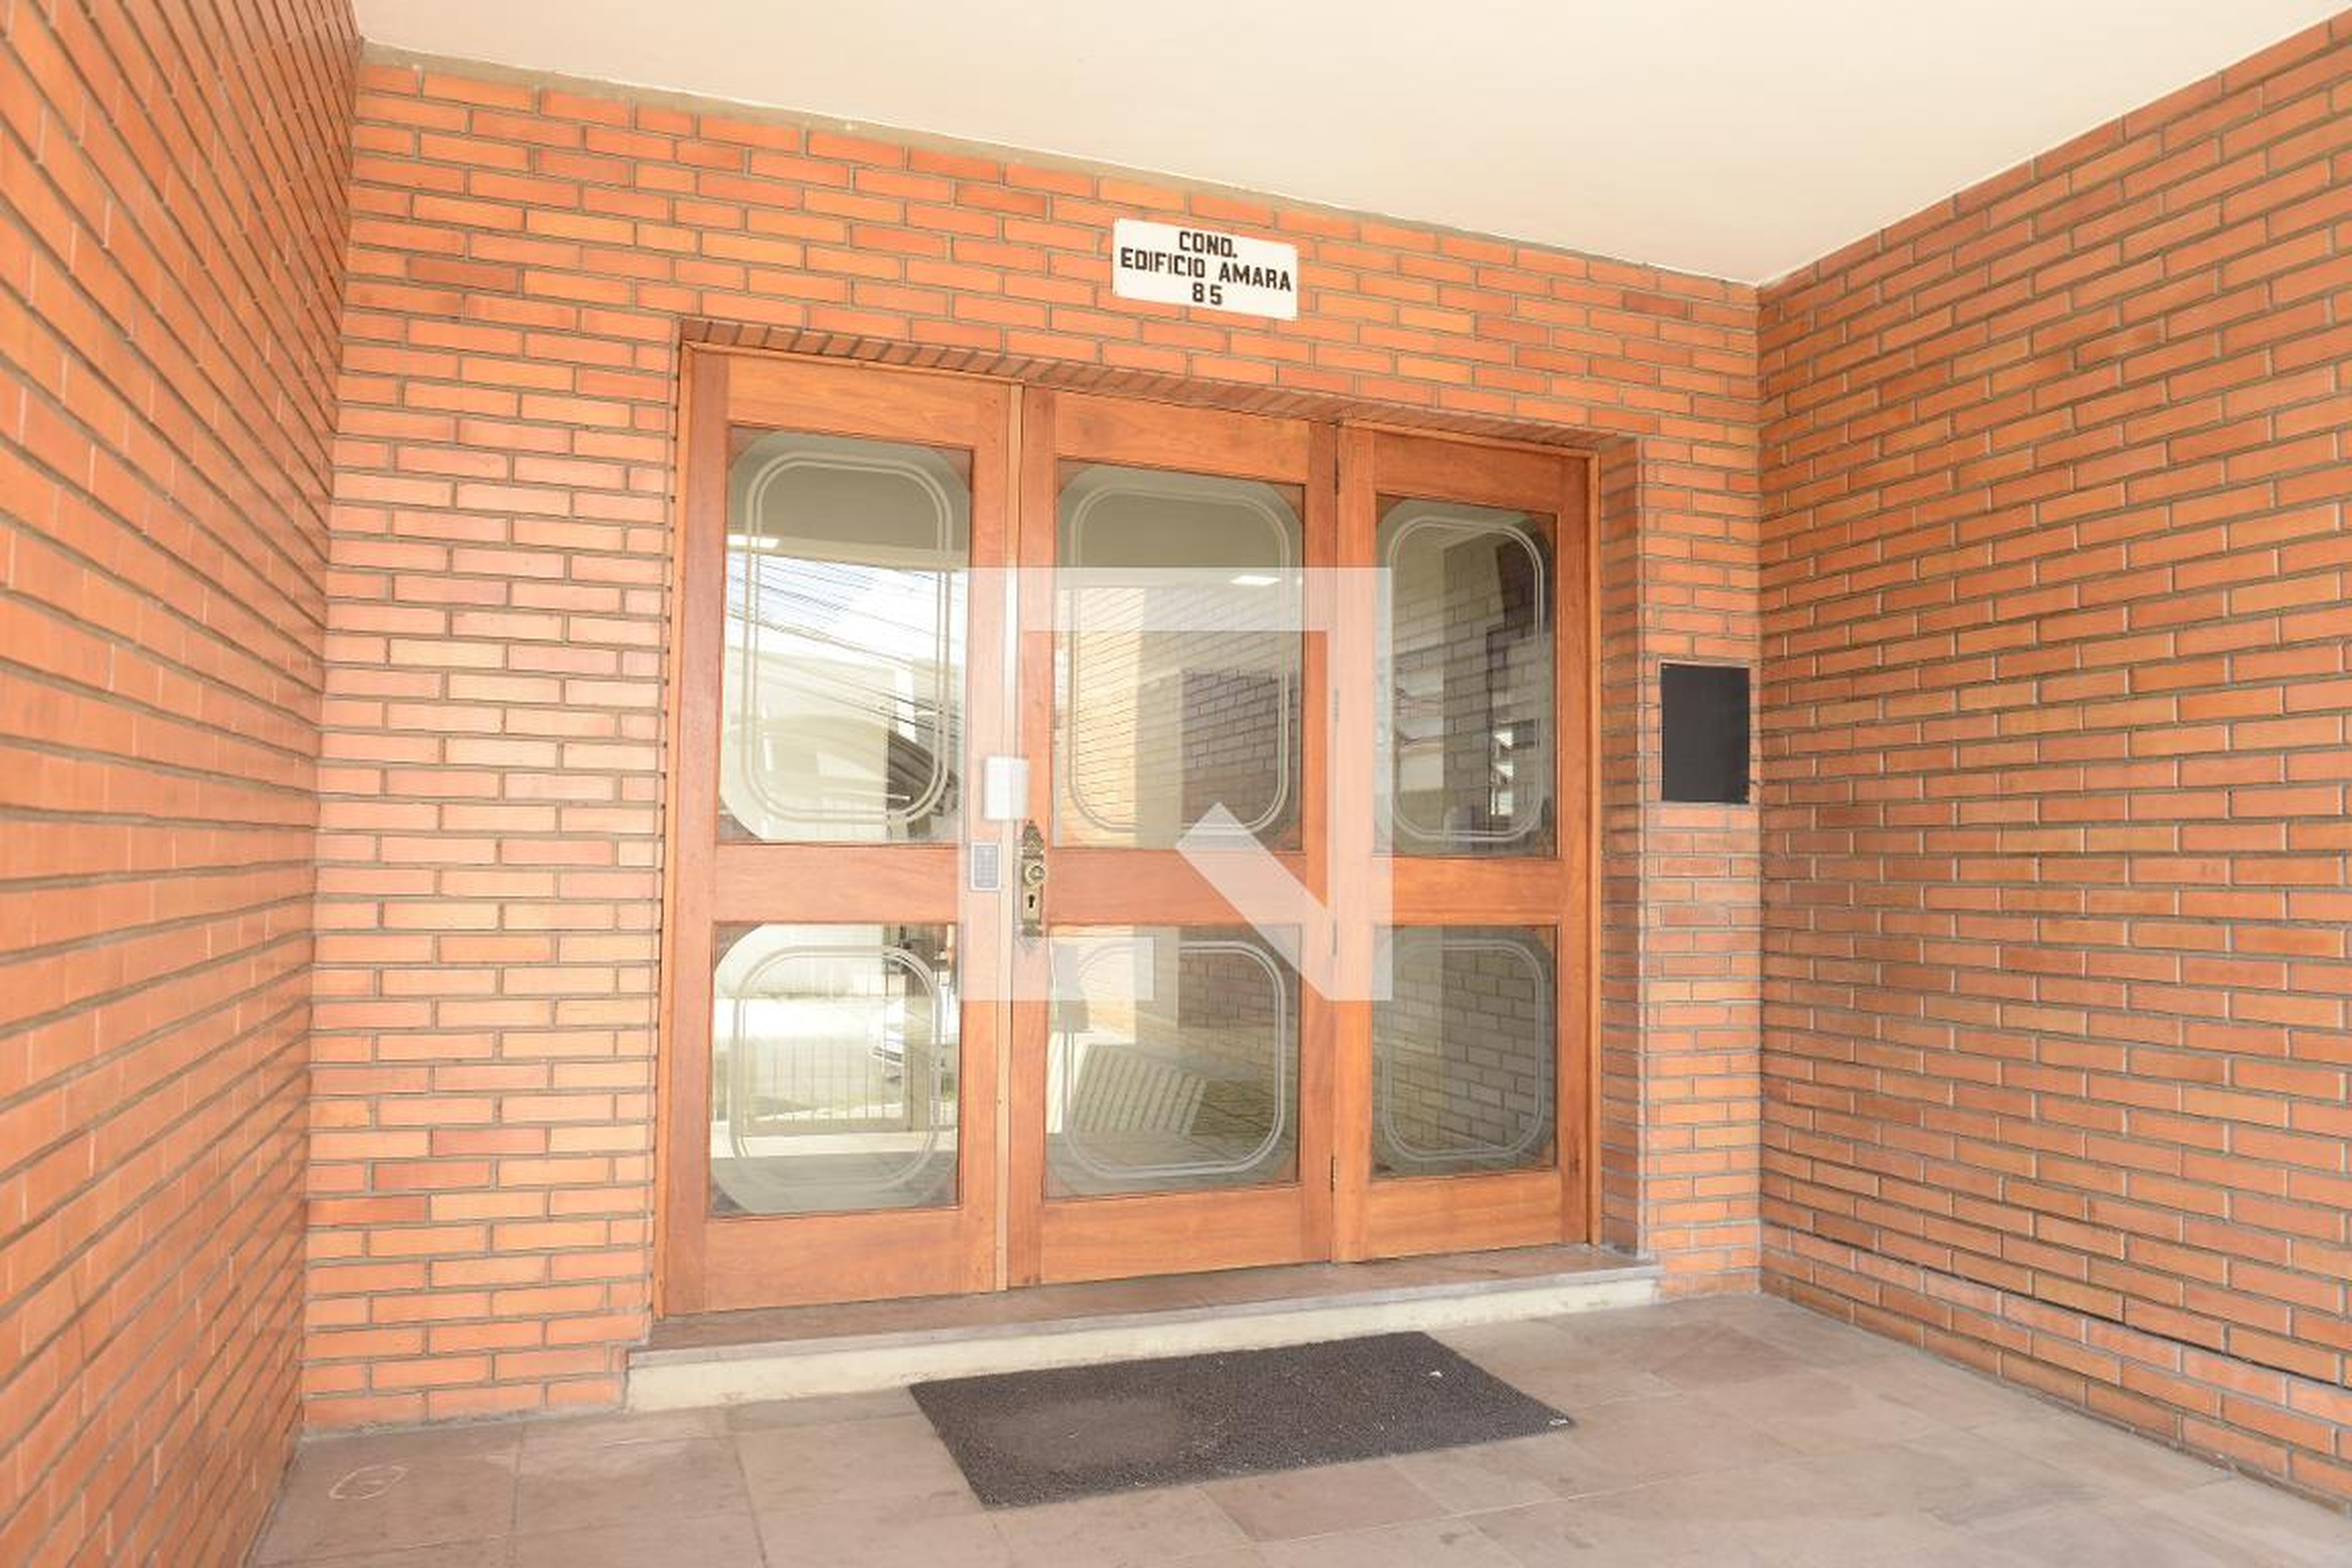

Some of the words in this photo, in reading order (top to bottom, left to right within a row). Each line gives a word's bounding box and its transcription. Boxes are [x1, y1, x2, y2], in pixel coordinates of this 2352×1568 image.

[1178, 230, 1238, 258] COND.
[1120, 247, 1205, 279] EDIFICIO
[1219, 262, 1292, 292] AMARA
[1192, 282, 1223, 306] 85
